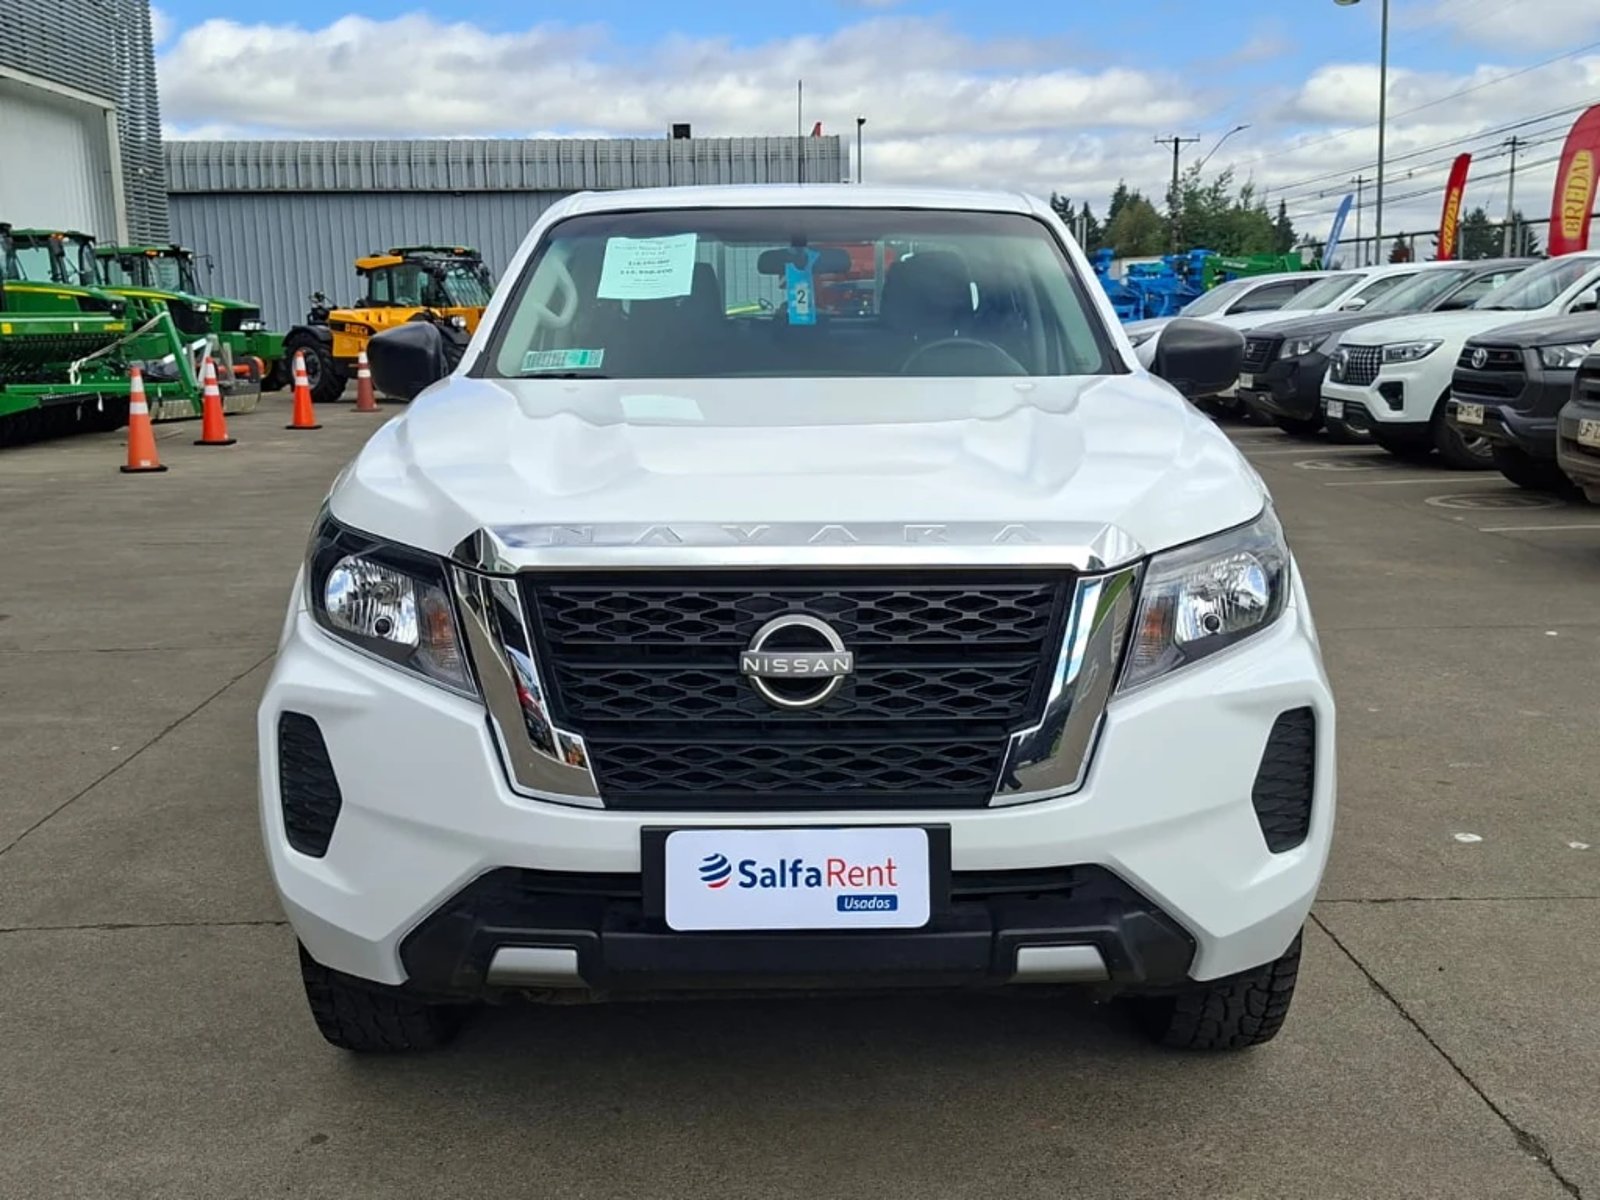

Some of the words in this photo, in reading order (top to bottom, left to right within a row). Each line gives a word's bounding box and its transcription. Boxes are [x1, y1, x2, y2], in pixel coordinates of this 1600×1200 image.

[797, 289, 806, 304] 2
[550, 523, 1042, 545] NAVARA
[743, 657, 849, 673] NISSAN
[844, 897, 890, 909] Usados
